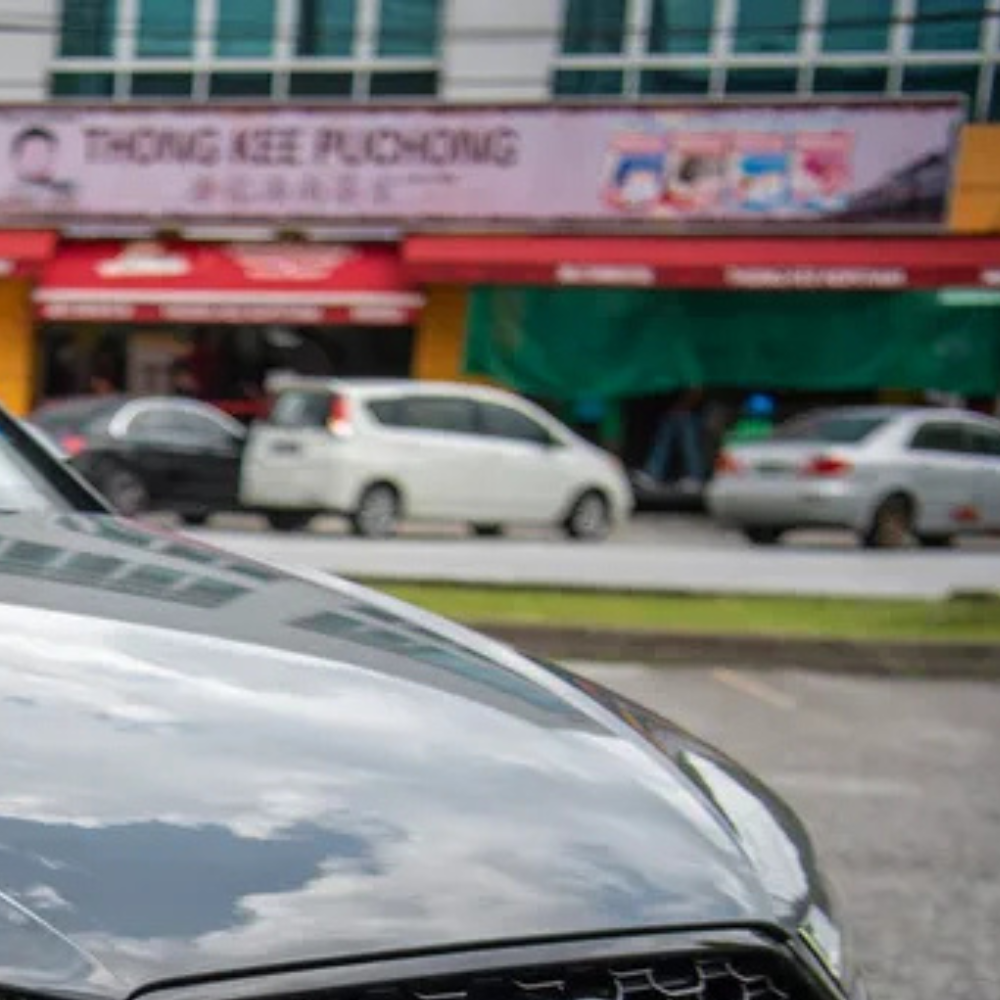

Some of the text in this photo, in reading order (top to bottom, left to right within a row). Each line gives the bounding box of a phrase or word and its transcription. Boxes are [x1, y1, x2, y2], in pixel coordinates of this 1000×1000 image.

[83, 126, 520, 168] THONG KEE PUCHONG
